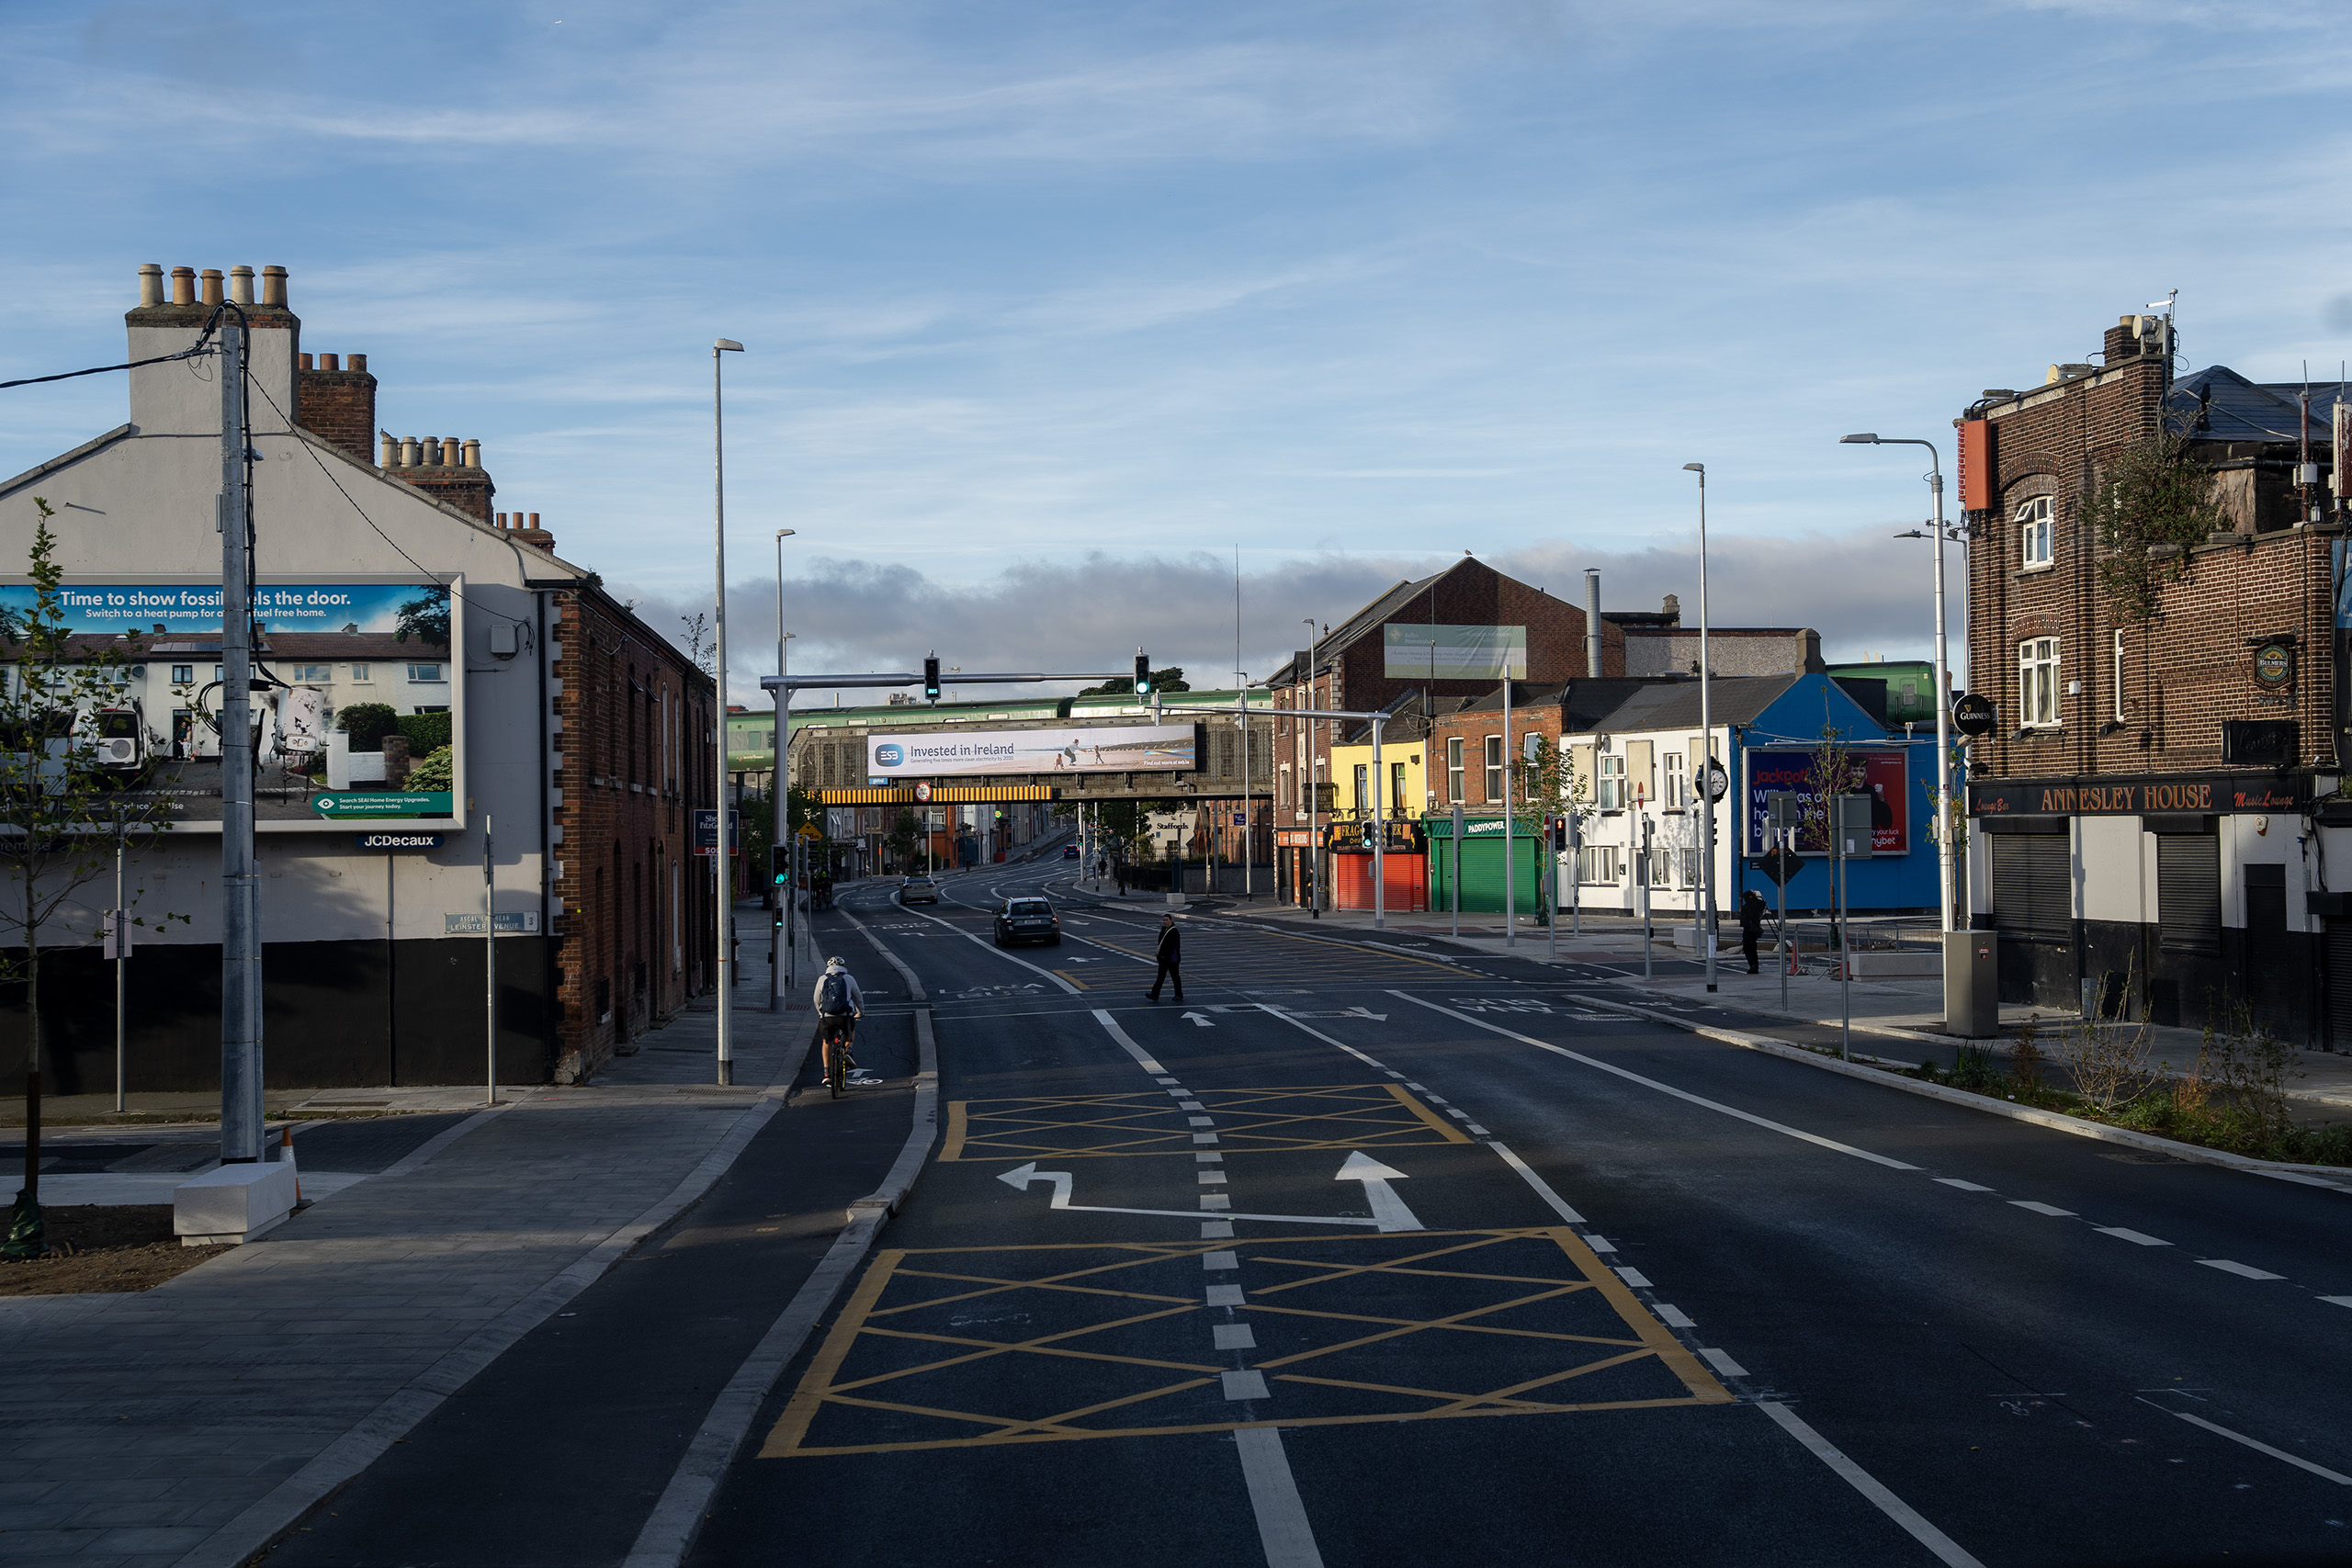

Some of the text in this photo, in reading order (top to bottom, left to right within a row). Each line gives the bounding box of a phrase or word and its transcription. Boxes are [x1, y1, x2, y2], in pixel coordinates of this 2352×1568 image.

[61, 591, 103, 606] Time
[107, 592, 126, 606] to
[130, 591, 176, 606] show
[179, 591, 223, 606] fossil
[275, 590, 304, 606] the
[307, 590, 351, 605] door.
[85, 608, 124, 618] Switch
[126, 609, 133, 618] to
[143, 608, 168, 618] heat
[171, 610, 198, 620] pump
[200, 608, 214, 618] for
[217, 610, 224, 618] a
[253, 608, 273, 618] fuel
[275, 607, 294, 617] free
[296, 607, 327, 617] home.
[2259, 659, 2287, 667] BULMERS
[1960, 710, 1991, 721] GUINNESS
[880, 750, 899, 761] ESB
[910, 742, 1014, 757] Invested in Ireland
[404, 796, 431, 805] Upgrades.
[2041, 784, 2213, 812] ANNESLEY HOUSE
[2233, 790, 2294, 811] Music Lounge
[1974, 797, 2010, 815] Lounge Bar
[1382, 823, 1402, 836] RER
[364, 835, 434, 847] JCDecaux
[1871, 836, 1896, 848] nybet
[528, 917, 534, 926] 3
